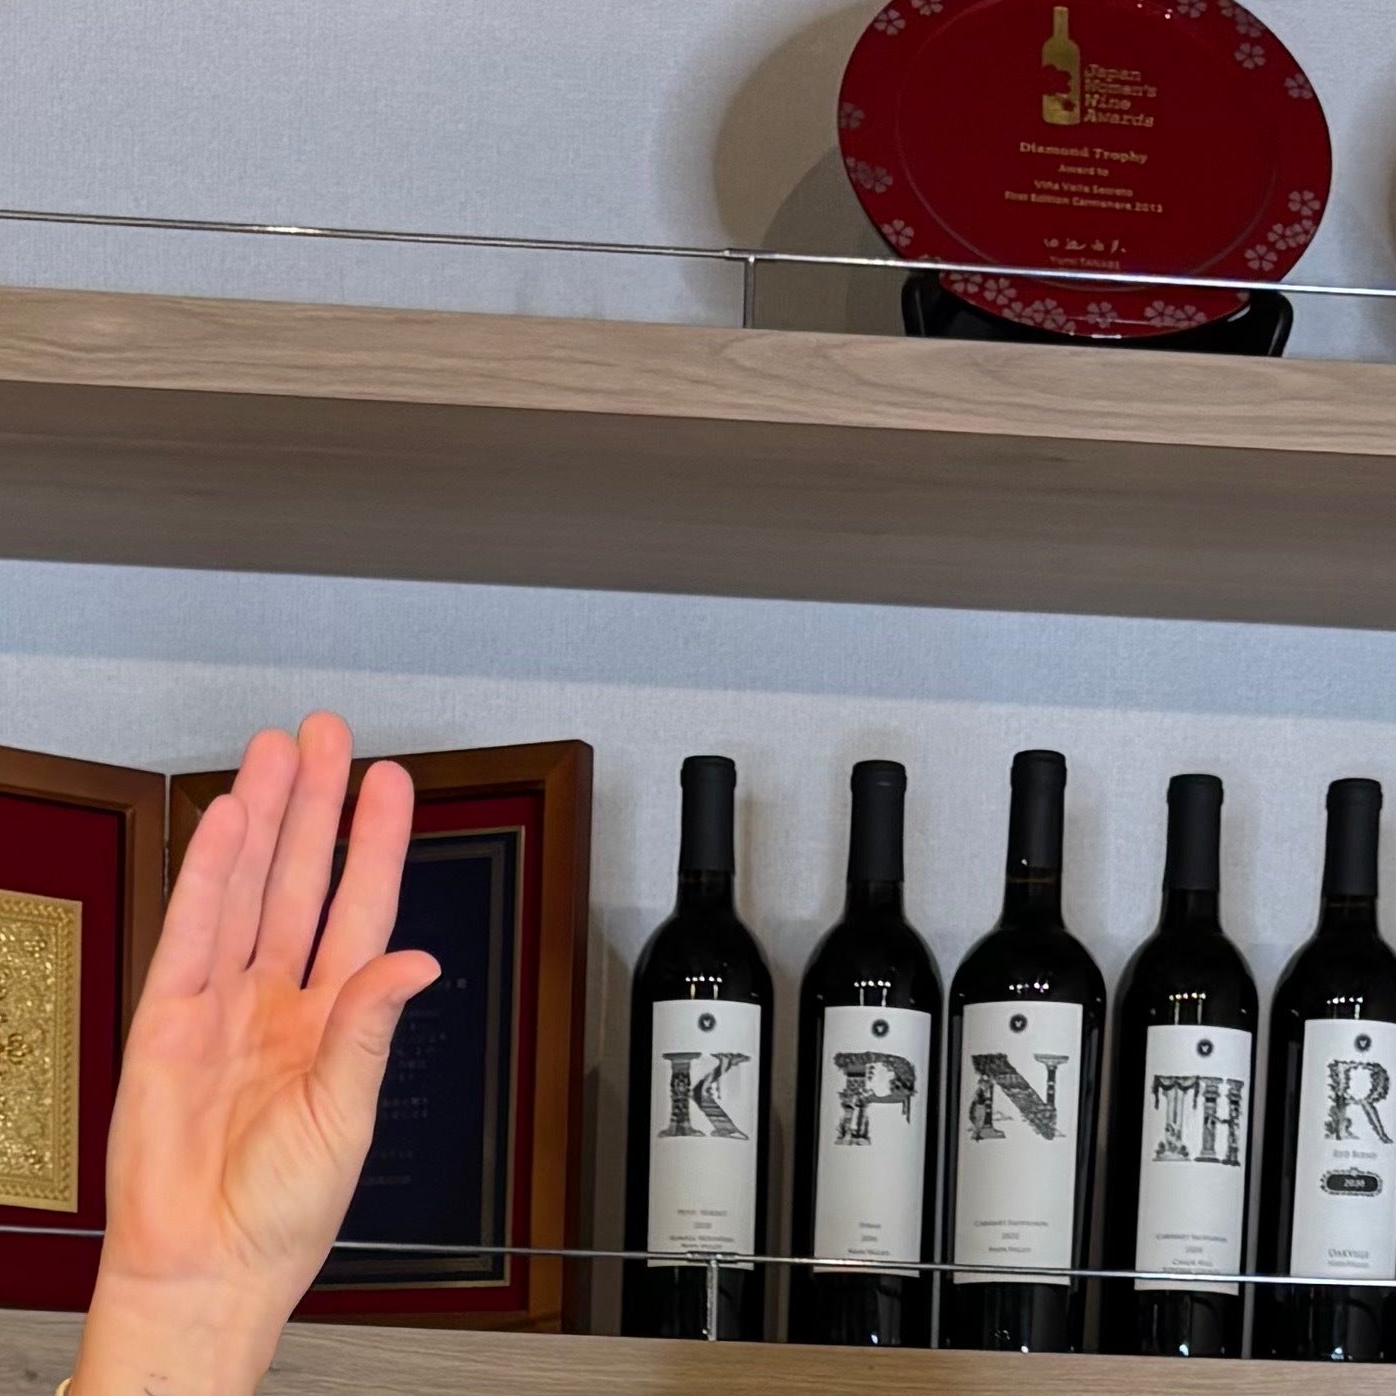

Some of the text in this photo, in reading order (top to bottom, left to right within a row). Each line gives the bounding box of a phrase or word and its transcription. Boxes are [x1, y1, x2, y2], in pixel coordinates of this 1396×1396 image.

[1084, 64, 1141, 81] Japan
[1084, 109, 1154, 127] Awards
[1085, 94, 1131, 110] Wine
[1020, 142, 1148, 164] Diamond Trophy
[657, 1051, 752, 1141] K
[833, 1051, 917, 1146] P
[968, 1053, 1069, 1142] N
[1324, 1059, 1394, 1144] R
